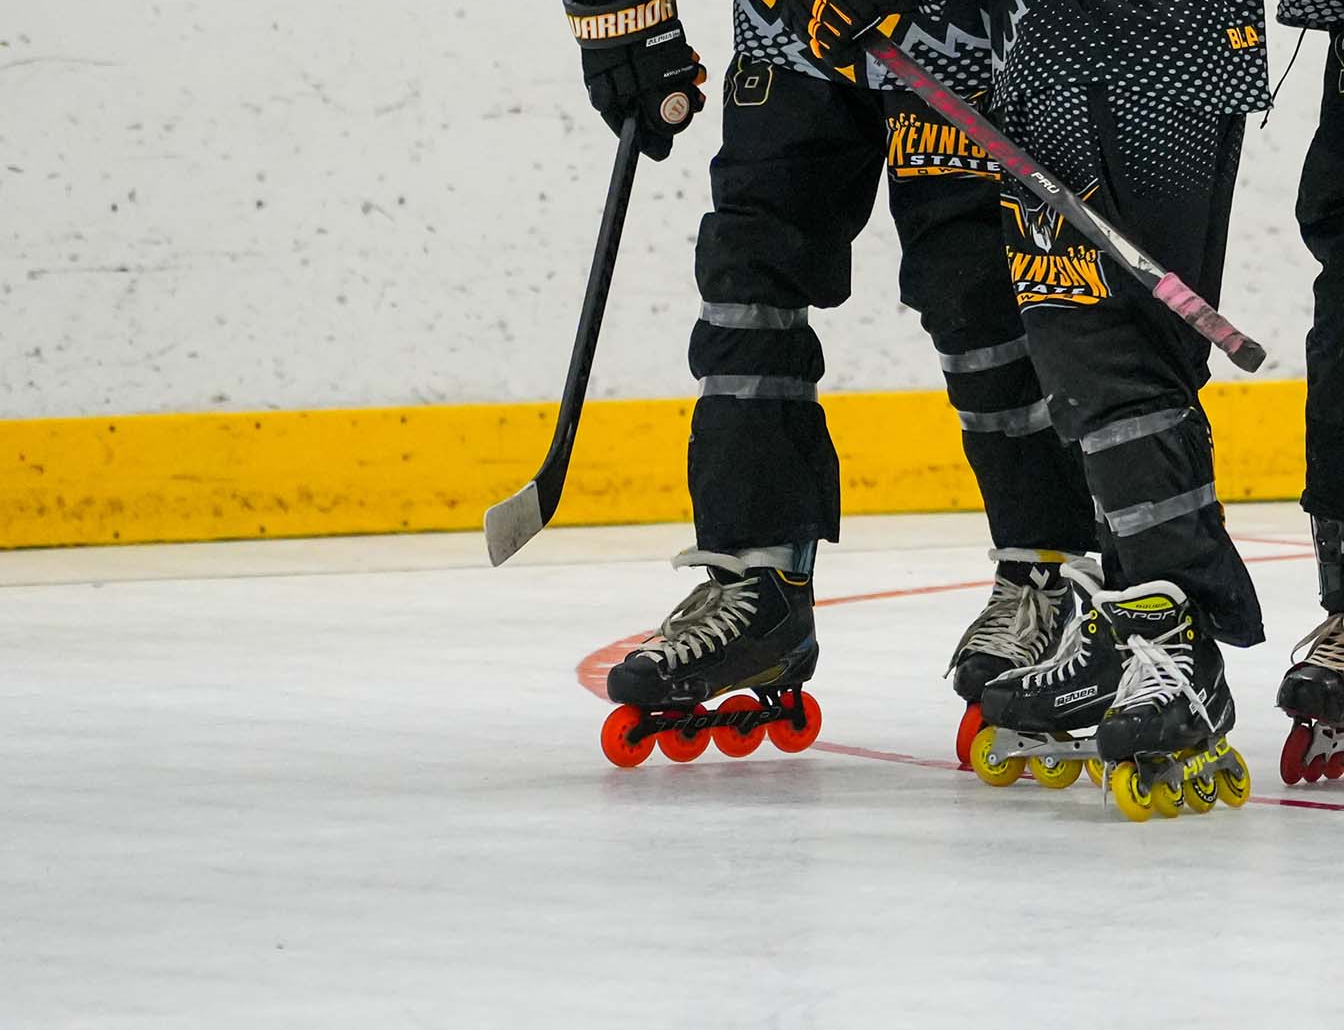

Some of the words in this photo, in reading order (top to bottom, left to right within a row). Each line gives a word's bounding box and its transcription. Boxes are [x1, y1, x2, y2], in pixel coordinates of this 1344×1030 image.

[909, 154, 1001, 172] STATE
[1030, 171, 1060, 195] PRO
[1108, 603, 1177, 621] VAPOR
[1055, 687, 1097, 706] BAUER
